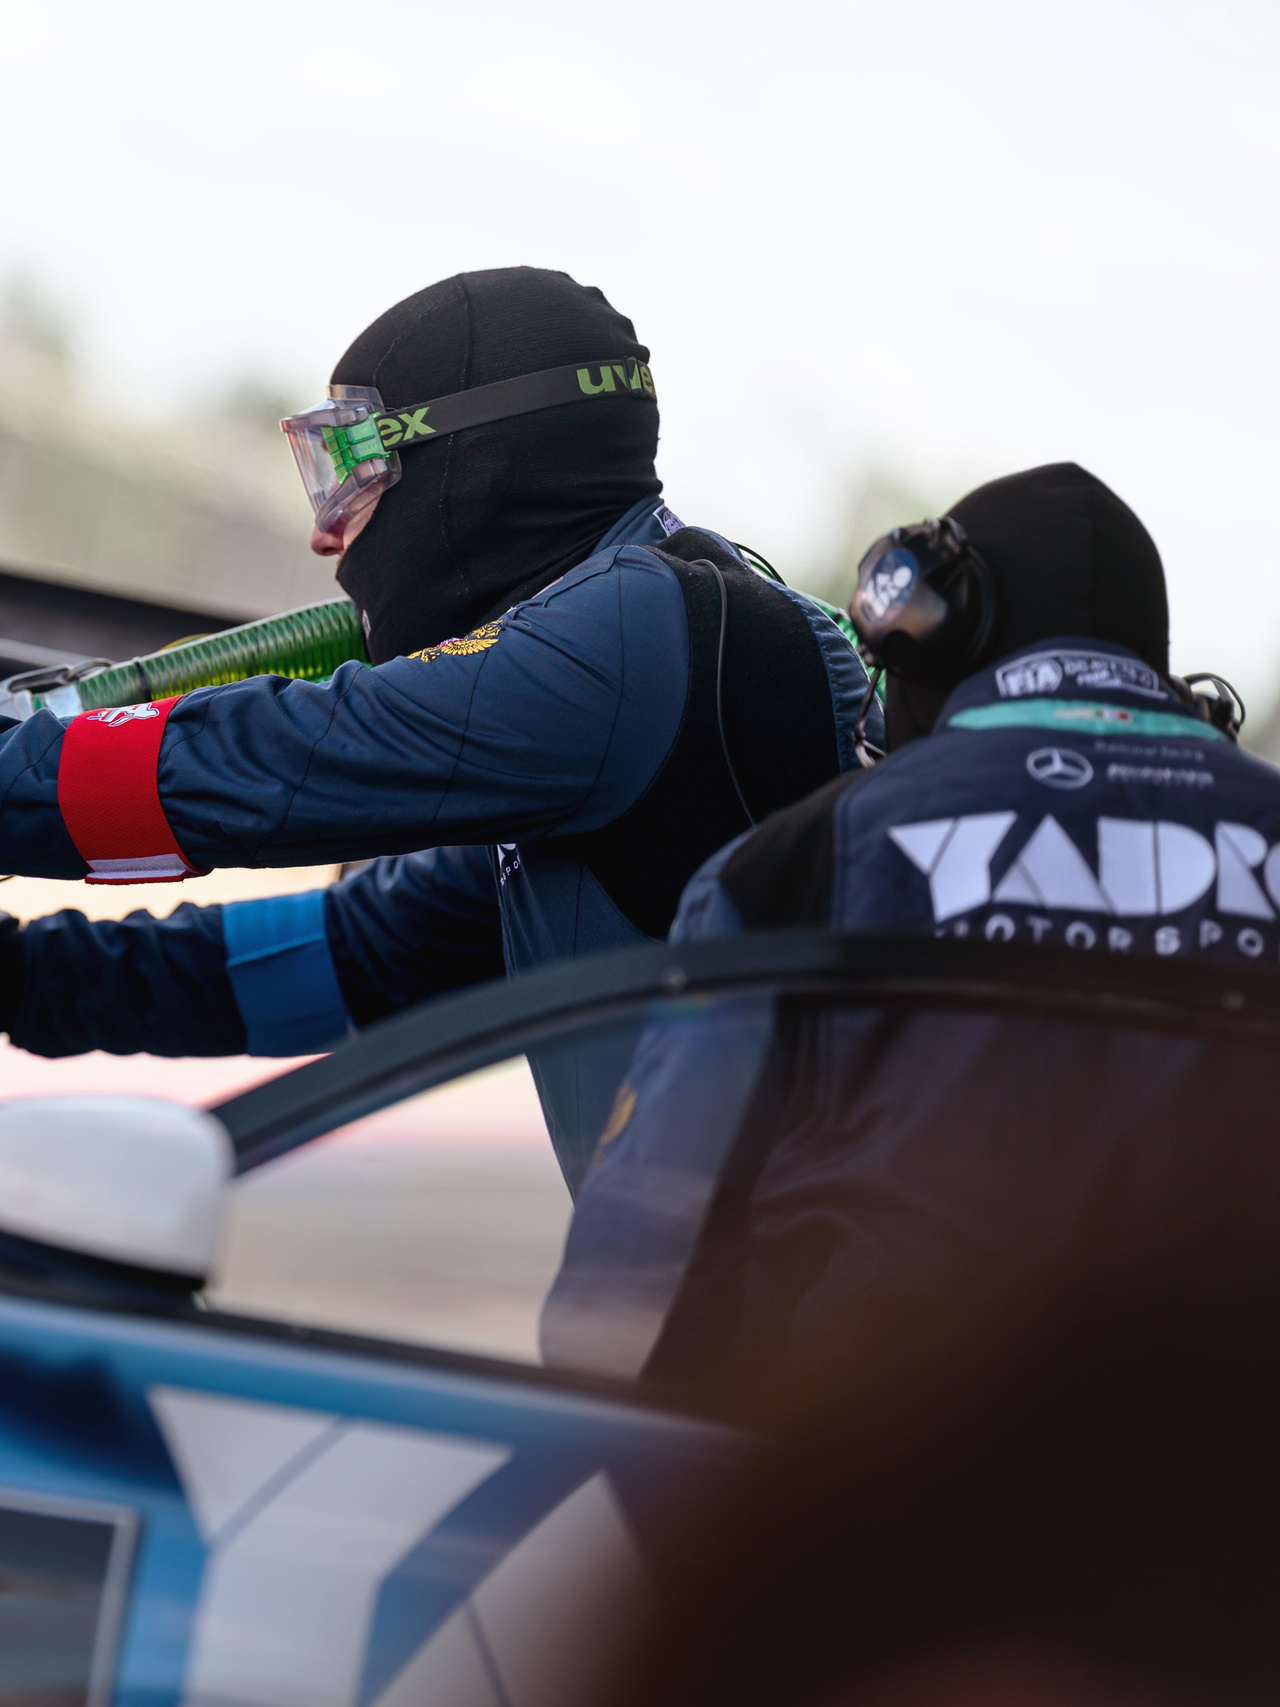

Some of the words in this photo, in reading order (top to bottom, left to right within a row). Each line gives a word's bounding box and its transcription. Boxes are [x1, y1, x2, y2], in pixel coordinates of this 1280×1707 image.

[576, 364, 655, 395] uve
[377, 406, 437, 447] ex
[887, 809, 1280, 922] YADR
